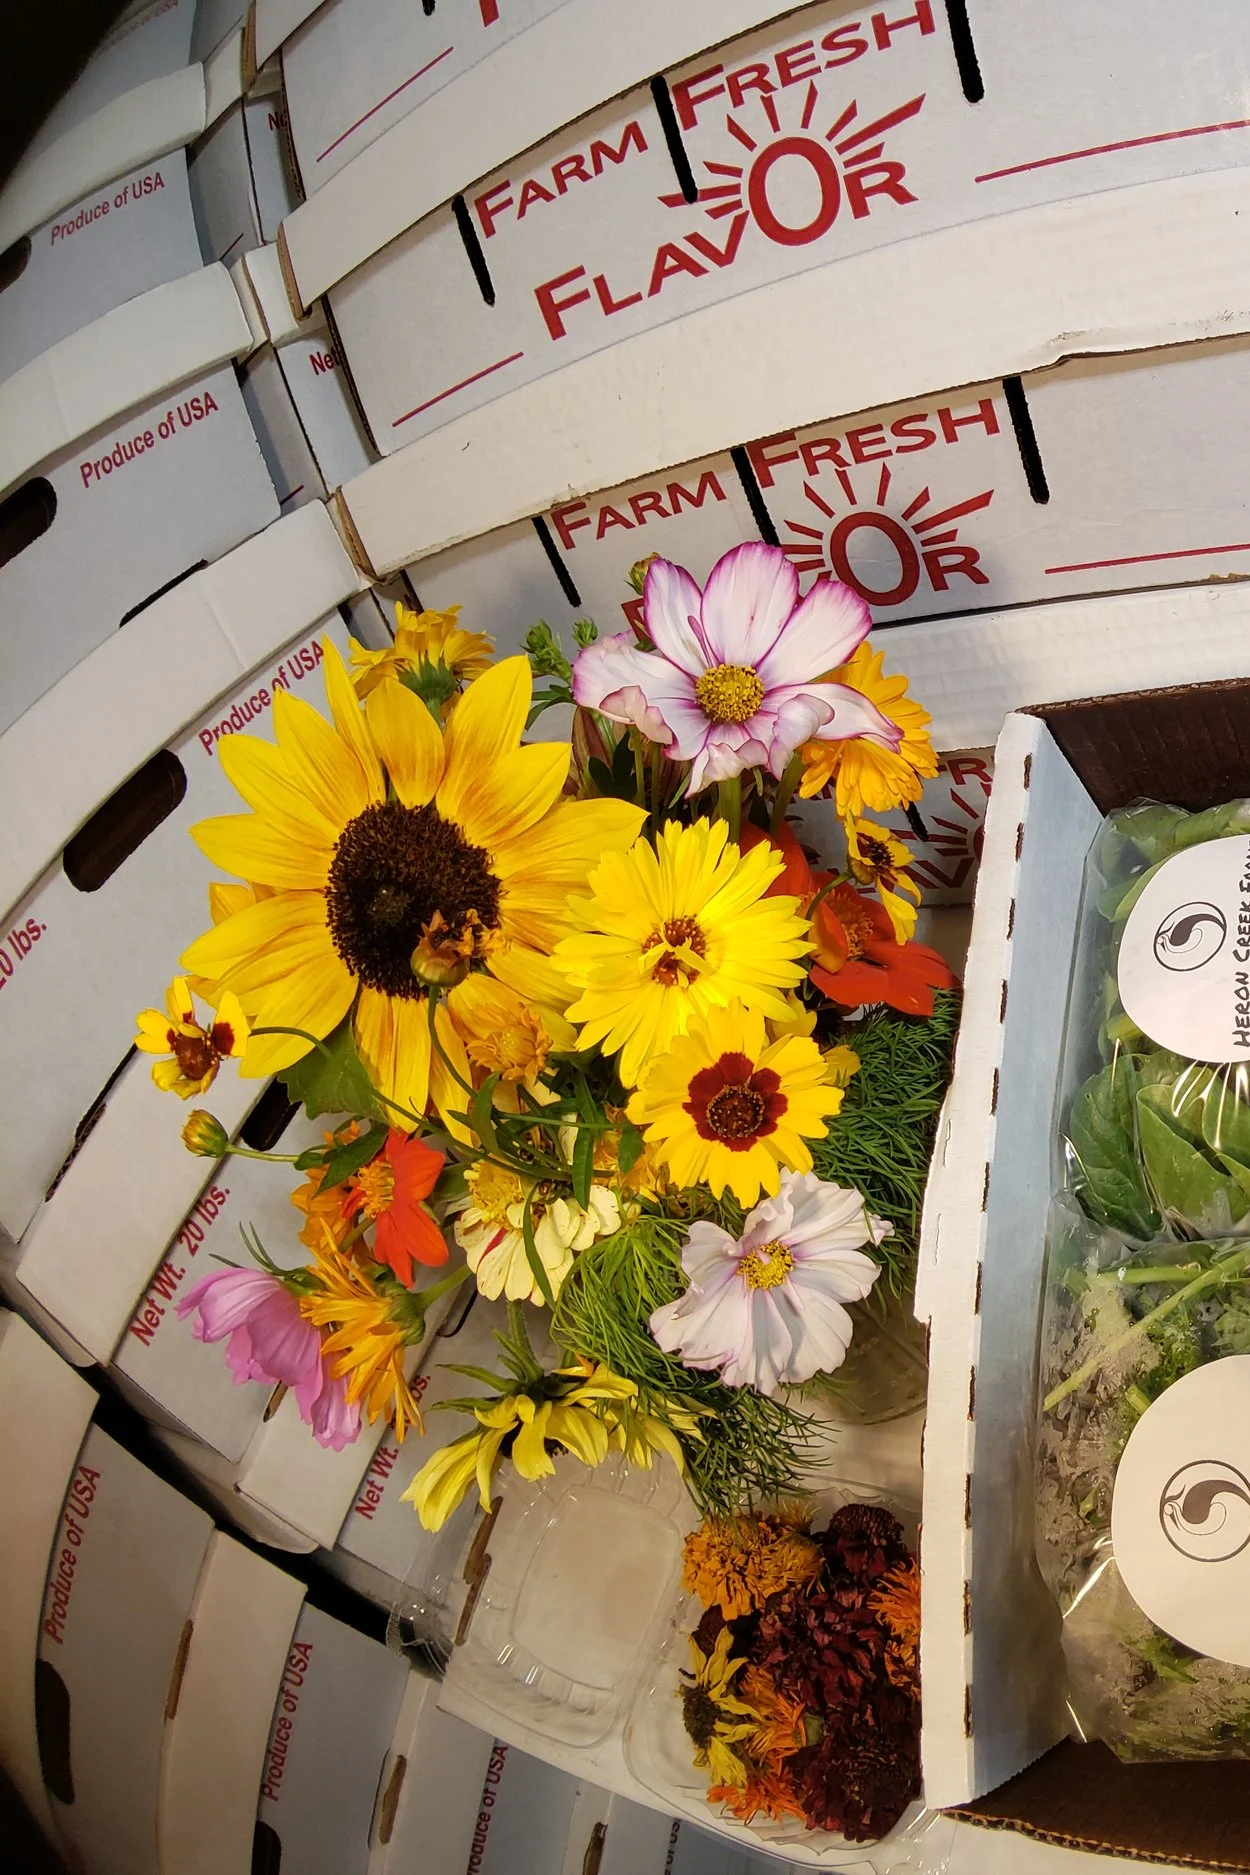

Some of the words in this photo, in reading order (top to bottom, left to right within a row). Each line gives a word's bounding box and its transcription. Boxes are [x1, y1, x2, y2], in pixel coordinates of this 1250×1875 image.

[474, 121, 649, 239] FARM
[671, 0, 936, 130] FRESH
[51, 201, 110, 246] Produce
[114, 186, 128, 208] of
[132, 172, 165, 199] USA
[534, 137, 918, 341] FLAVOR
[80, 430, 154, 488] Produce
[158, 411, 176, 439] of
[177, 392, 219, 427] USA
[550, 470, 727, 550] FARM
[746, 398, 1001, 488] FRESH
[198, 688, 271, 756] Produce
[287, 640, 325, 680] USA
[7, 918, 47, 961] lbs.
[1232, 971, 1250, 1047] HERON
[130, 1296, 166, 1347] Net
[151, 1262, 186, 1301] Wt.
[178, 1219, 205, 1257] 20
[194, 1185, 230, 1226] lbs.
[67, 1466, 101, 1519] USA
[355, 1479, 384, 1520] Net
[370, 1447, 399, 1479] Wt.
[65, 1512, 84, 1547] of
[44, 1549, 77, 1646] Produce
[281, 1686, 299, 1713] of
[283, 1642, 313, 1687] USA
[261, 1717, 292, 1802] Produce
[467, 1812, 491, 1875] roduce
[486, 1746, 508, 1784] USA
